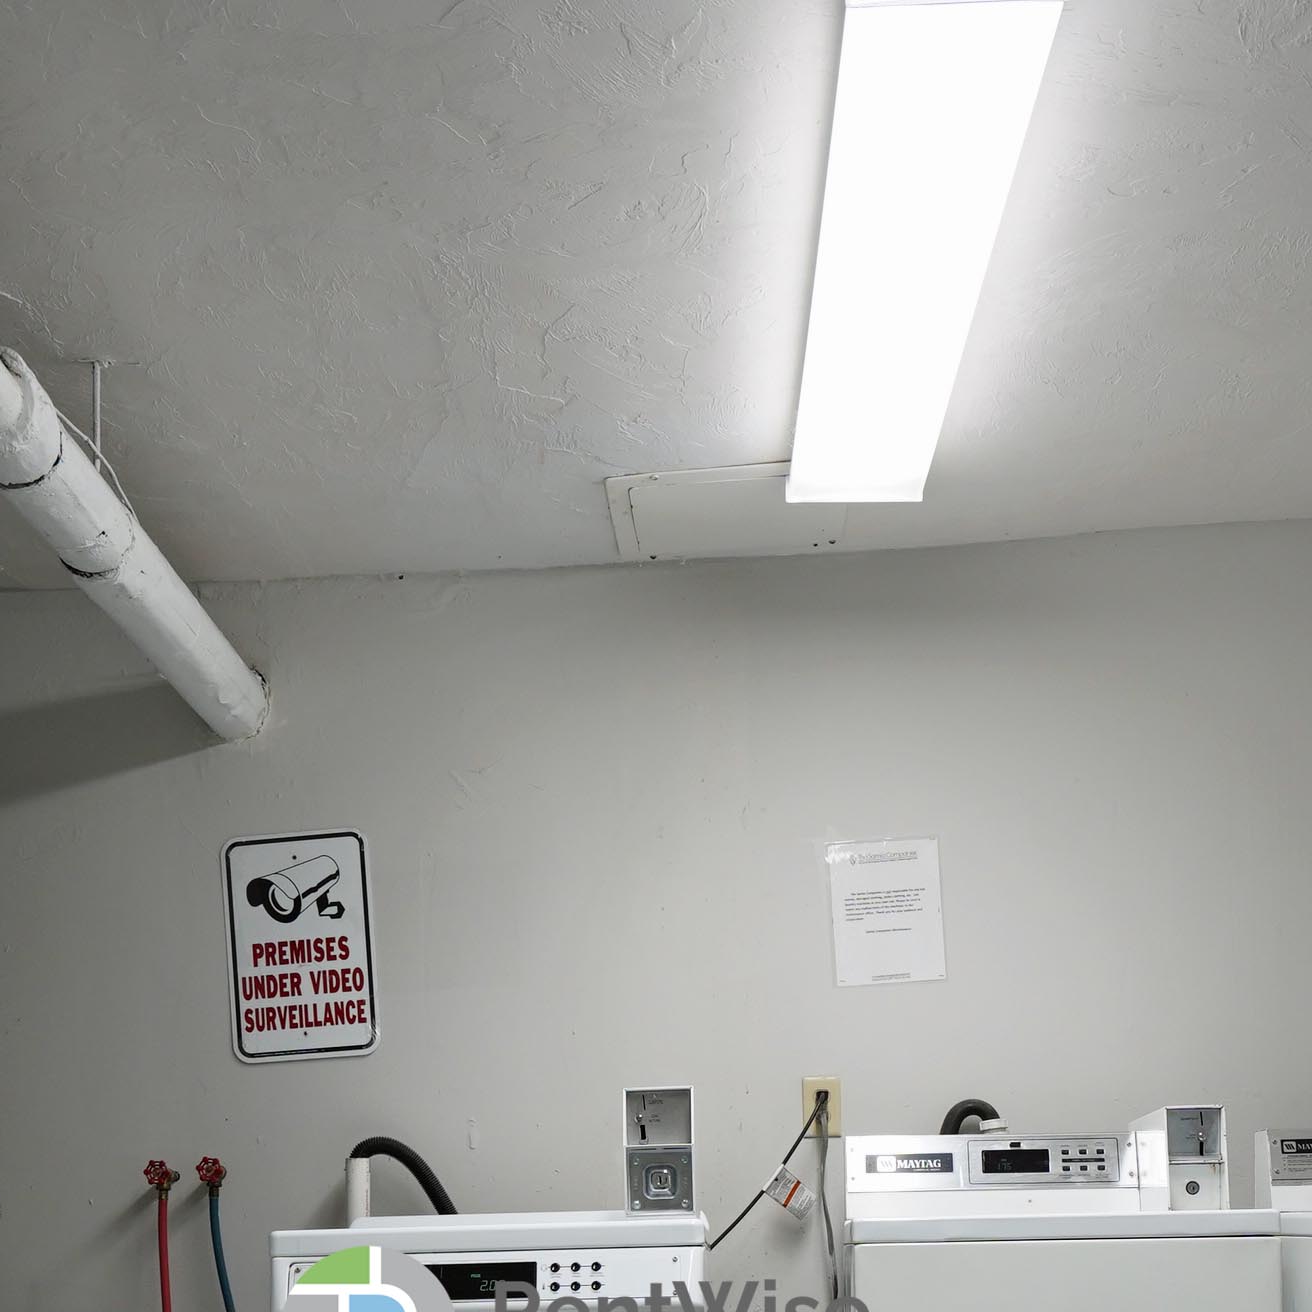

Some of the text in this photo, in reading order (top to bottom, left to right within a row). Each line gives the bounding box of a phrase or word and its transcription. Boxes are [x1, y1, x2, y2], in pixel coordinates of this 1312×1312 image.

[252, 936, 350, 967] PREMISES
[242, 967, 364, 1000] UNDER VIDEO
[244, 999, 367, 1033] SURVEILLANCE
[897, 1158, 942, 1169] MAYTAG
[479, 1279, 506, 1292] 2.0
